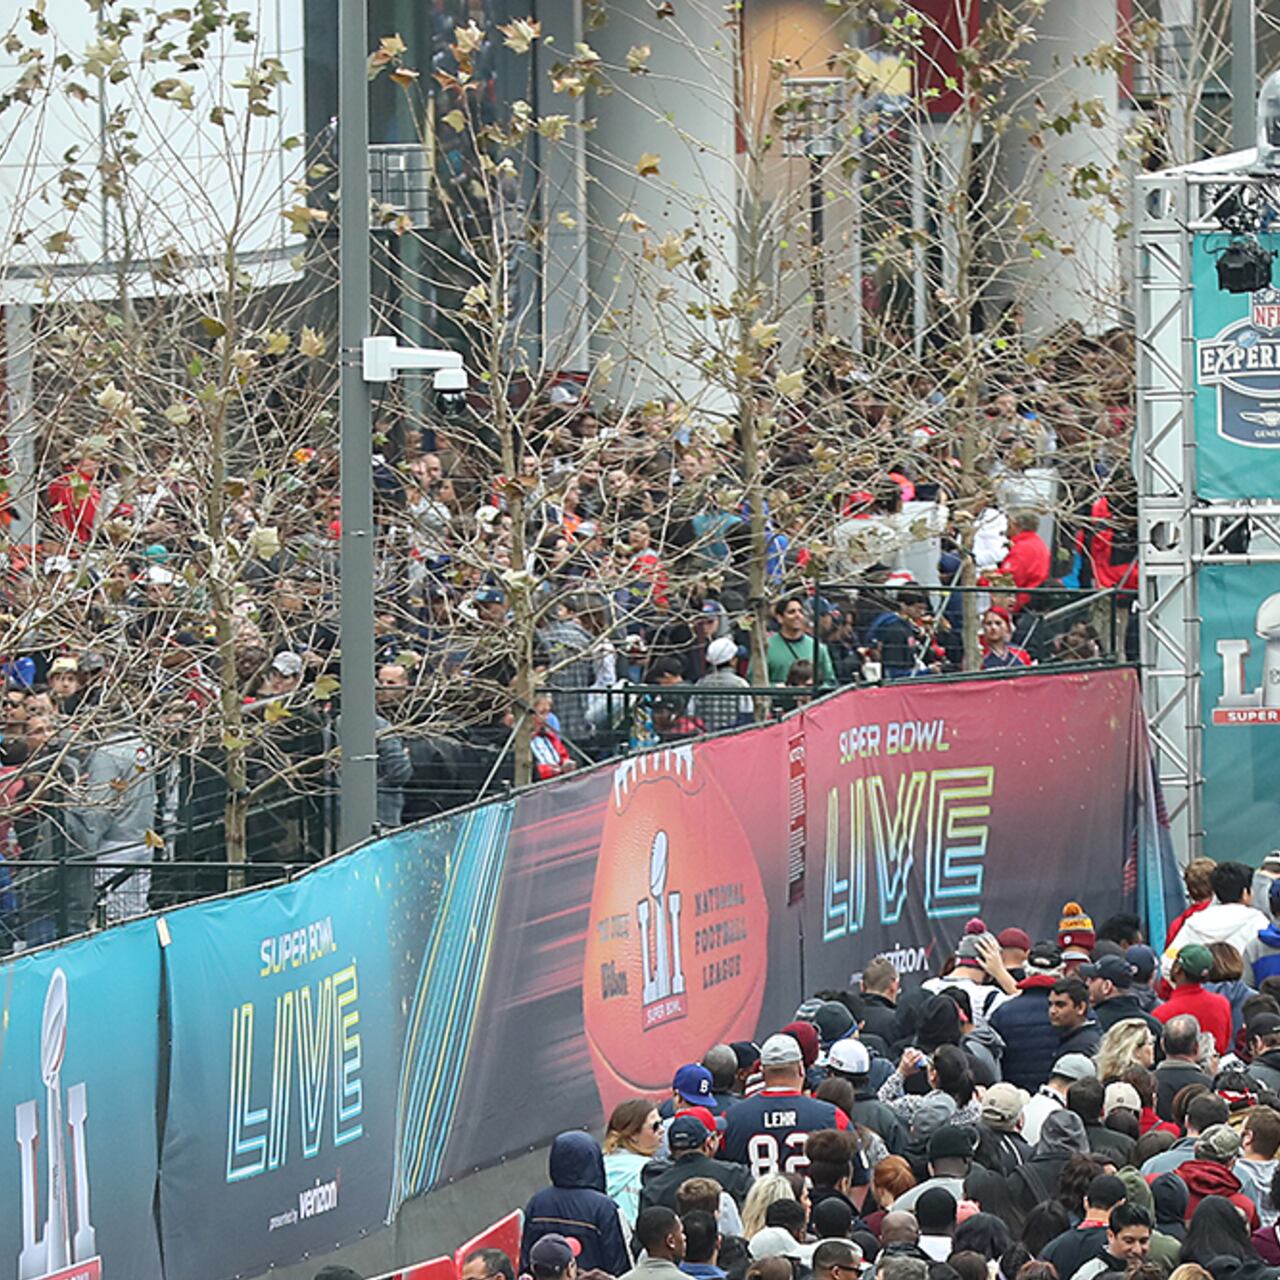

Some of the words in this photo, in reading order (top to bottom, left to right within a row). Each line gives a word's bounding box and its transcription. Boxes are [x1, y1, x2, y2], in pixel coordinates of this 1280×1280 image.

[1227, 709, 1279, 719] SUPER
[840, 724, 881, 764] SUPER
[887, 719, 950, 756] BOWL
[822, 765, 995, 943] LIVE
[694, 884, 746, 916] NATIONAL
[260, 927, 308, 977] SUPER
[309, 916, 337, 961] BOWL
[695, 918, 748, 955] FOOTBALL
[702, 954, 742, 989] LEAGUE
[226, 964, 363, 1183] LIVE
[764, 1110, 797, 1128] LEHR
[748, 1132, 812, 1182] 82
[298, 1177, 338, 1220] verizon
